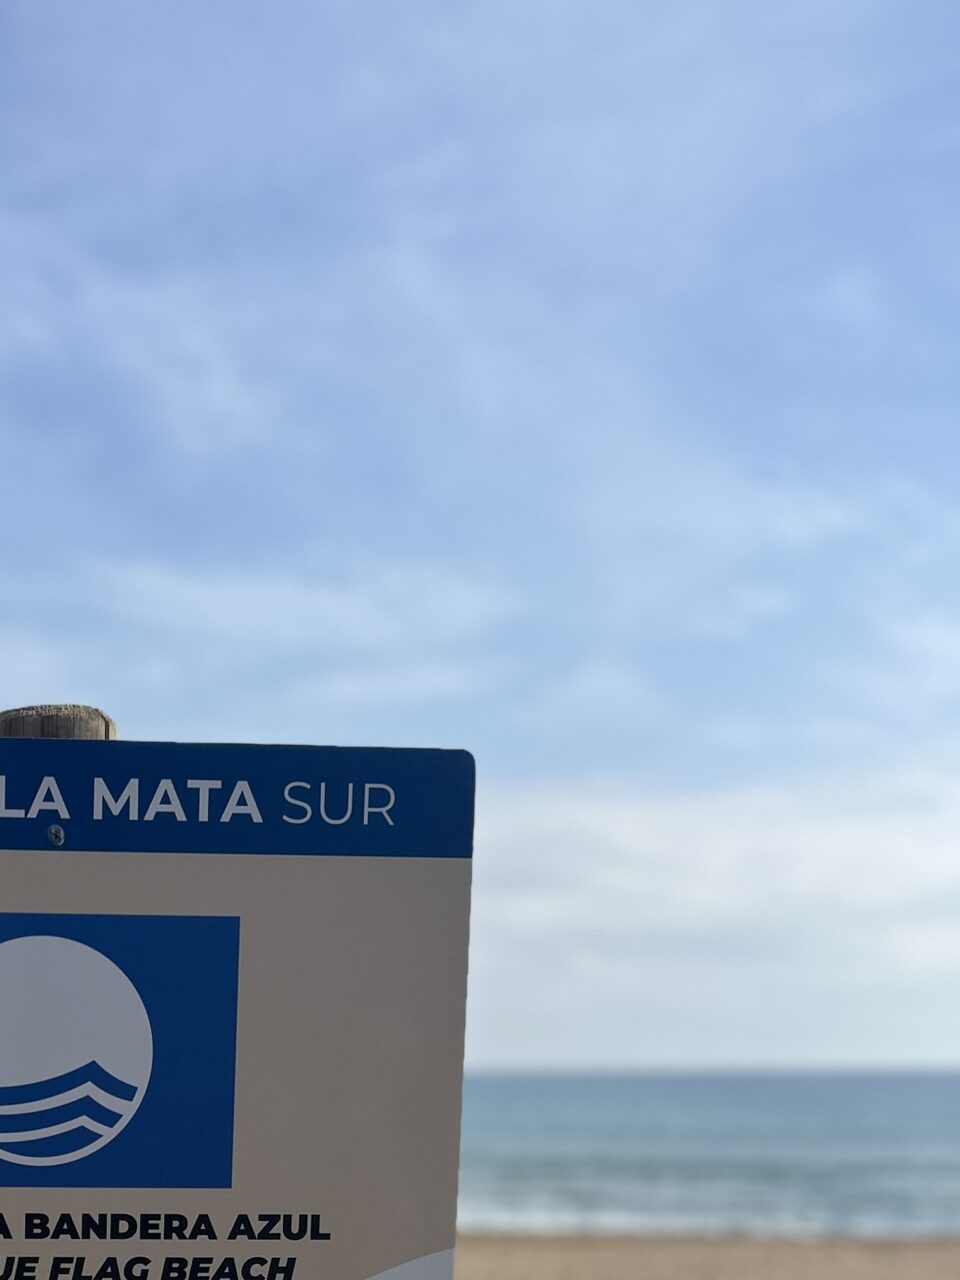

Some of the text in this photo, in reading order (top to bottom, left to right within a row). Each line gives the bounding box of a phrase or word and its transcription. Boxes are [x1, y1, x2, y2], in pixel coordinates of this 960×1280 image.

[92, 776, 264, 824] MATA
[281, 780, 397, 827] SUR
[24, 1213, 218, 1240] BANDERA
[227, 1213, 331, 1241] AZUL
